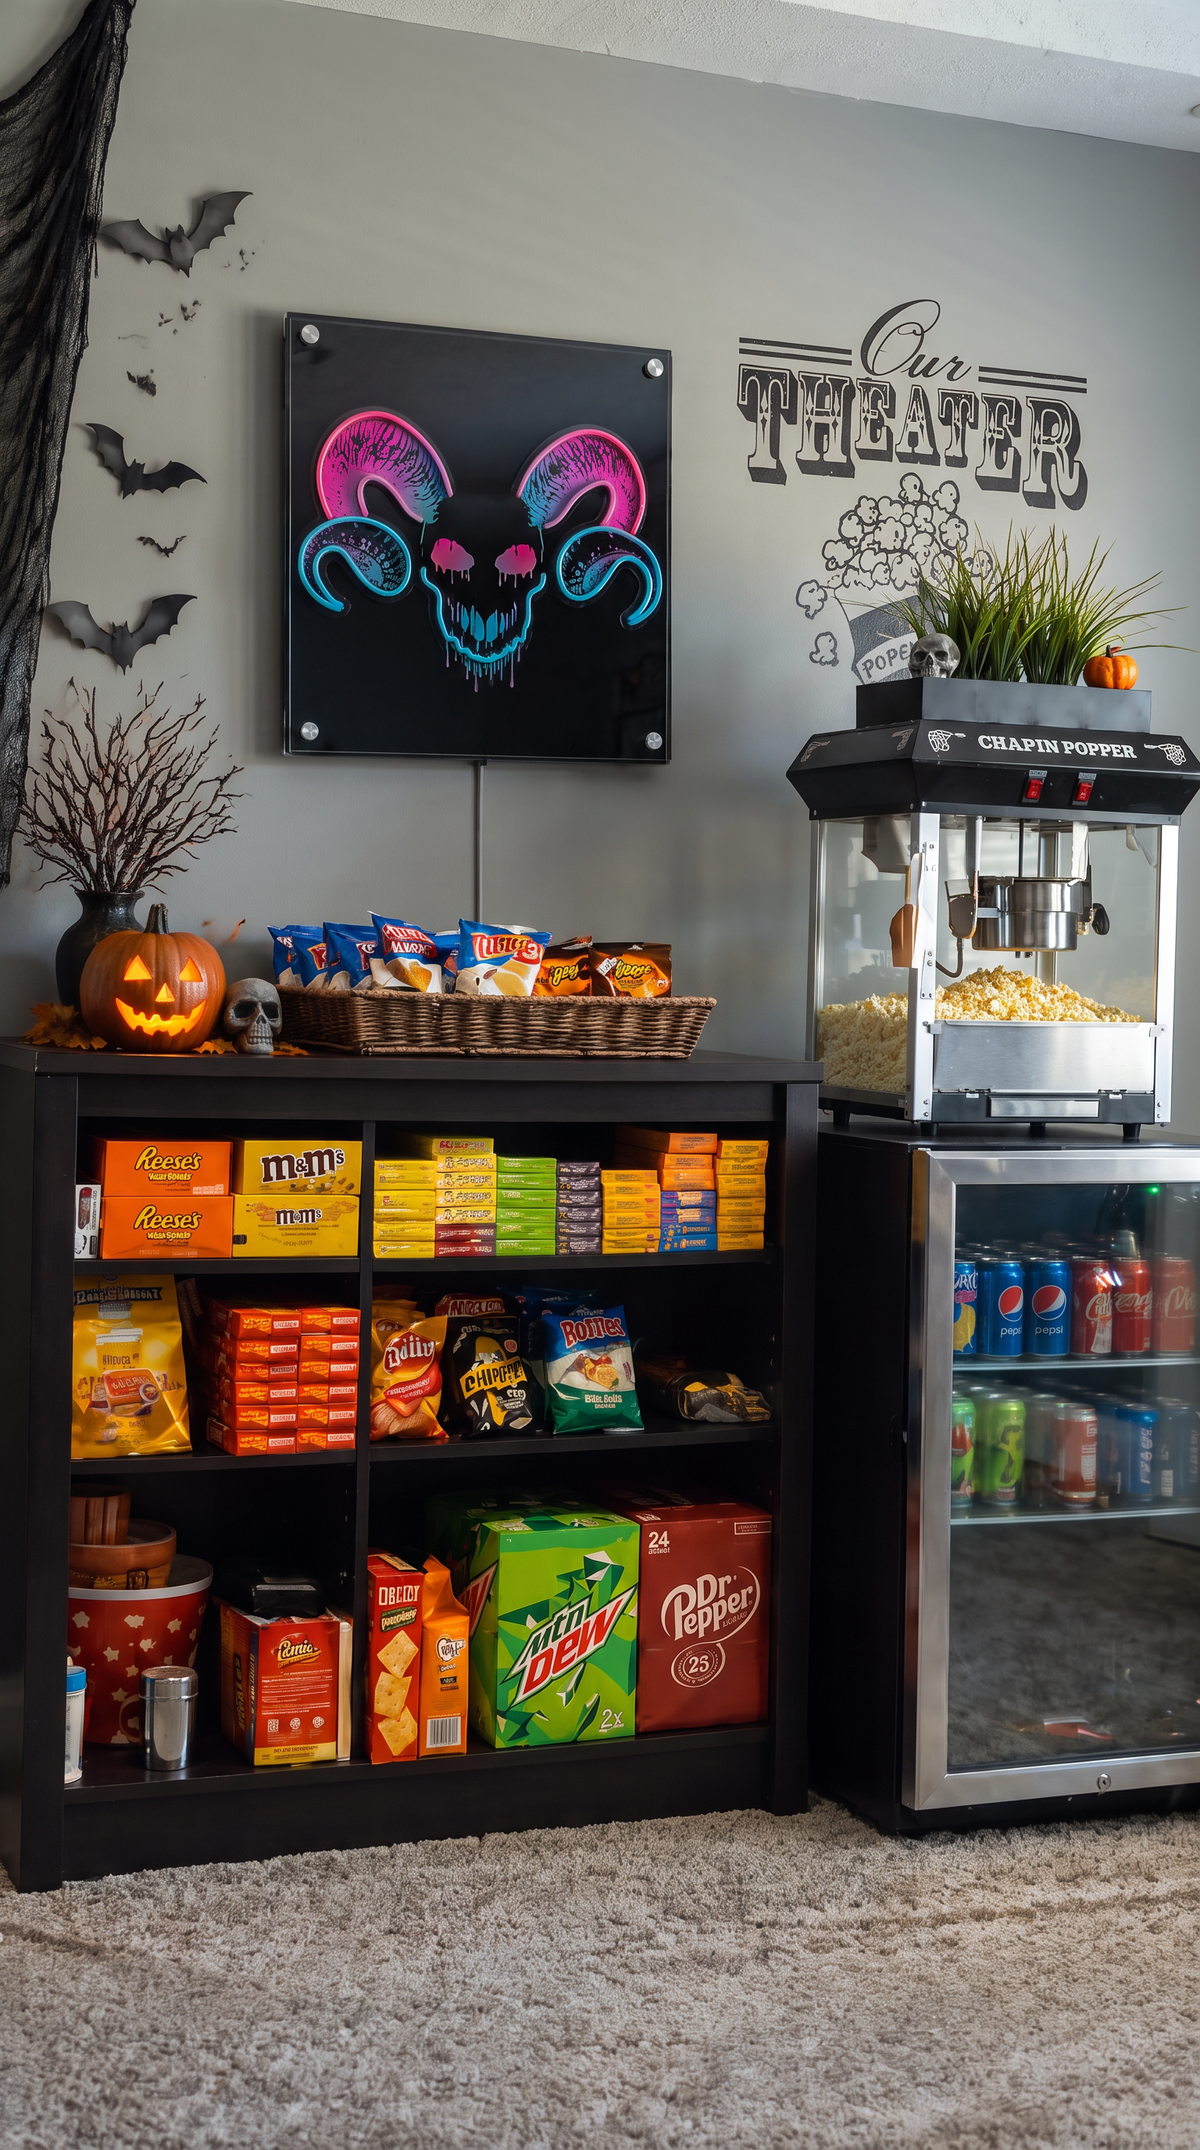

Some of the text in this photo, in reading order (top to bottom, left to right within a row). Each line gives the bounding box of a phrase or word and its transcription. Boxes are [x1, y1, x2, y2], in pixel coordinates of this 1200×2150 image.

[860, 299, 972, 381] Our
[737, 363, 1088, 510] THEATER
[861, 641, 914, 679] POPE
[977, 734, 1138, 759] CHAPIN POPPER
[135, 1145, 203, 1171] Reese's
[133, 1204, 203, 1230] Reese's
[1000, 1326, 1023, 1338] peps
[1034, 1325, 1064, 1336] pepsi
[648, 1530, 670, 1548] 24
[661, 1584, 754, 1641] Pepper
